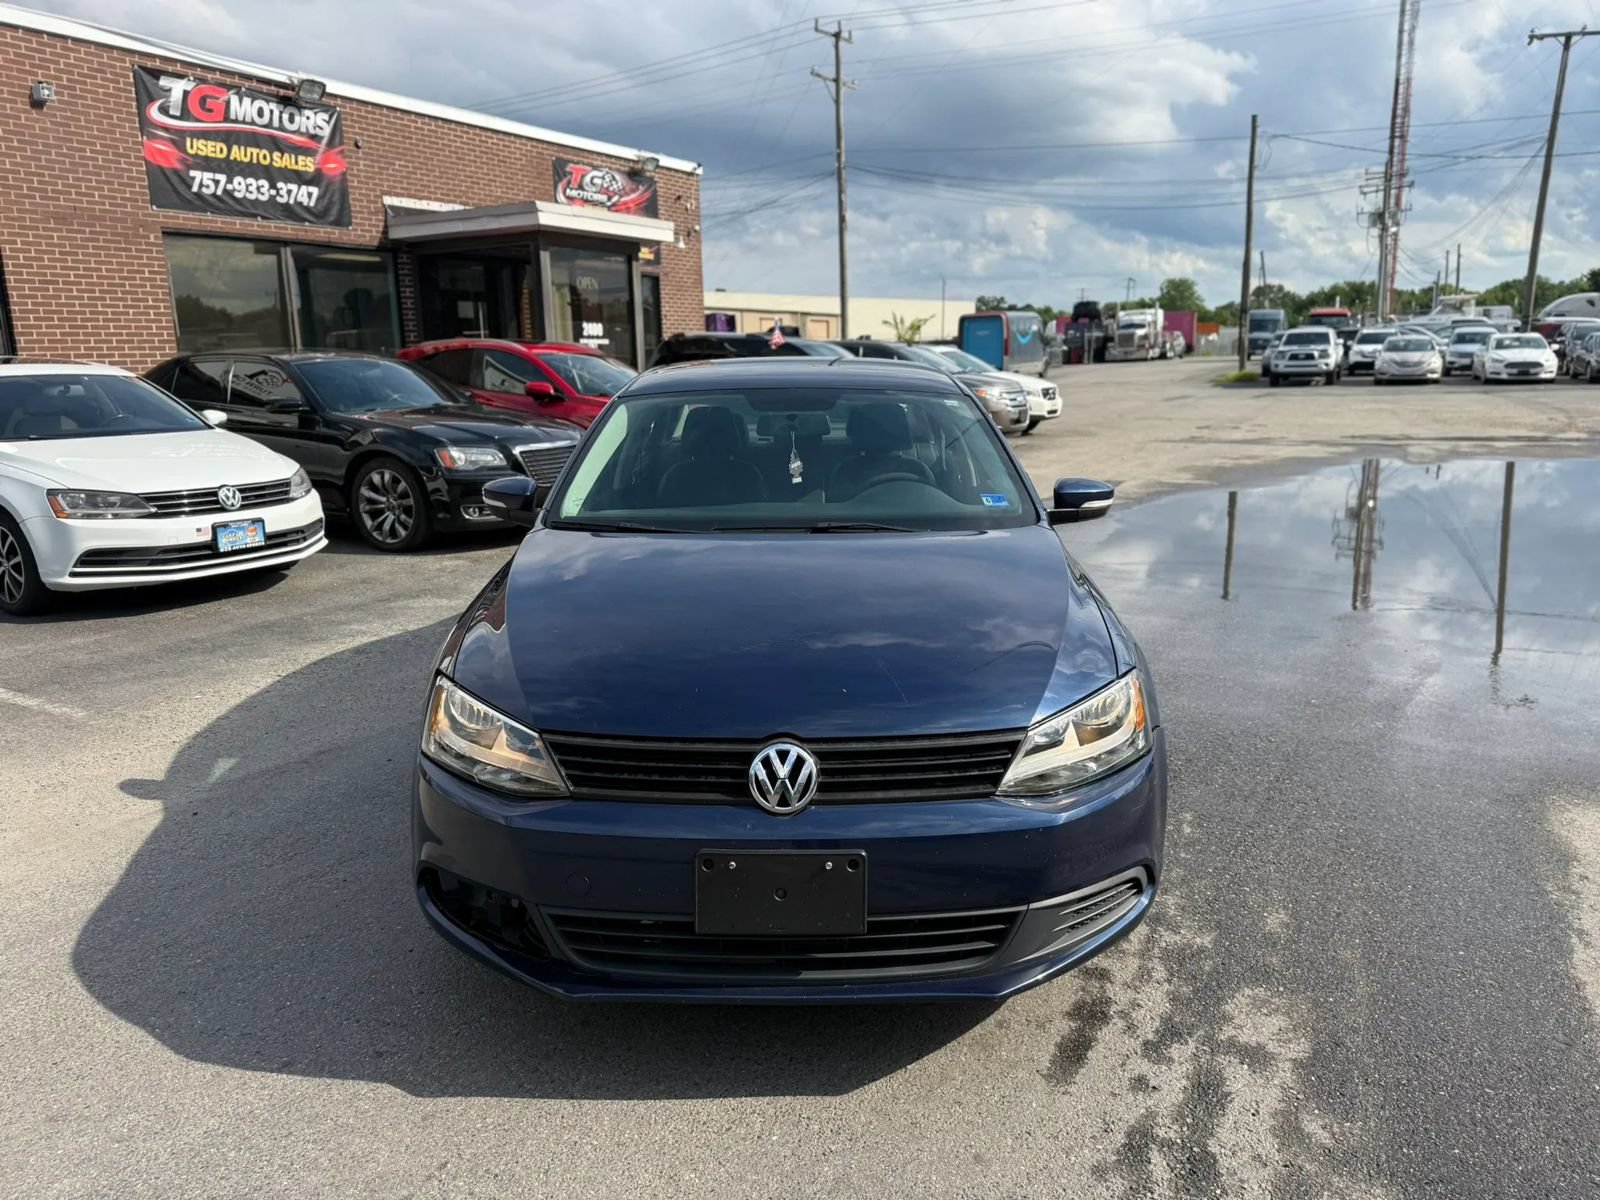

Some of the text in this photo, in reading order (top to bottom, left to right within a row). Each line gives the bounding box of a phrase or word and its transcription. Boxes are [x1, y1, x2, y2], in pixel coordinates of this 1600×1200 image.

[158, 75, 330, 136] TG MOTORS
[186, 137, 316, 173] USED AUTO SALES
[189, 169, 320, 207] 757-933-3747
[565, 187, 609, 203] MOTORS
[749, 741, 819, 814] VW
